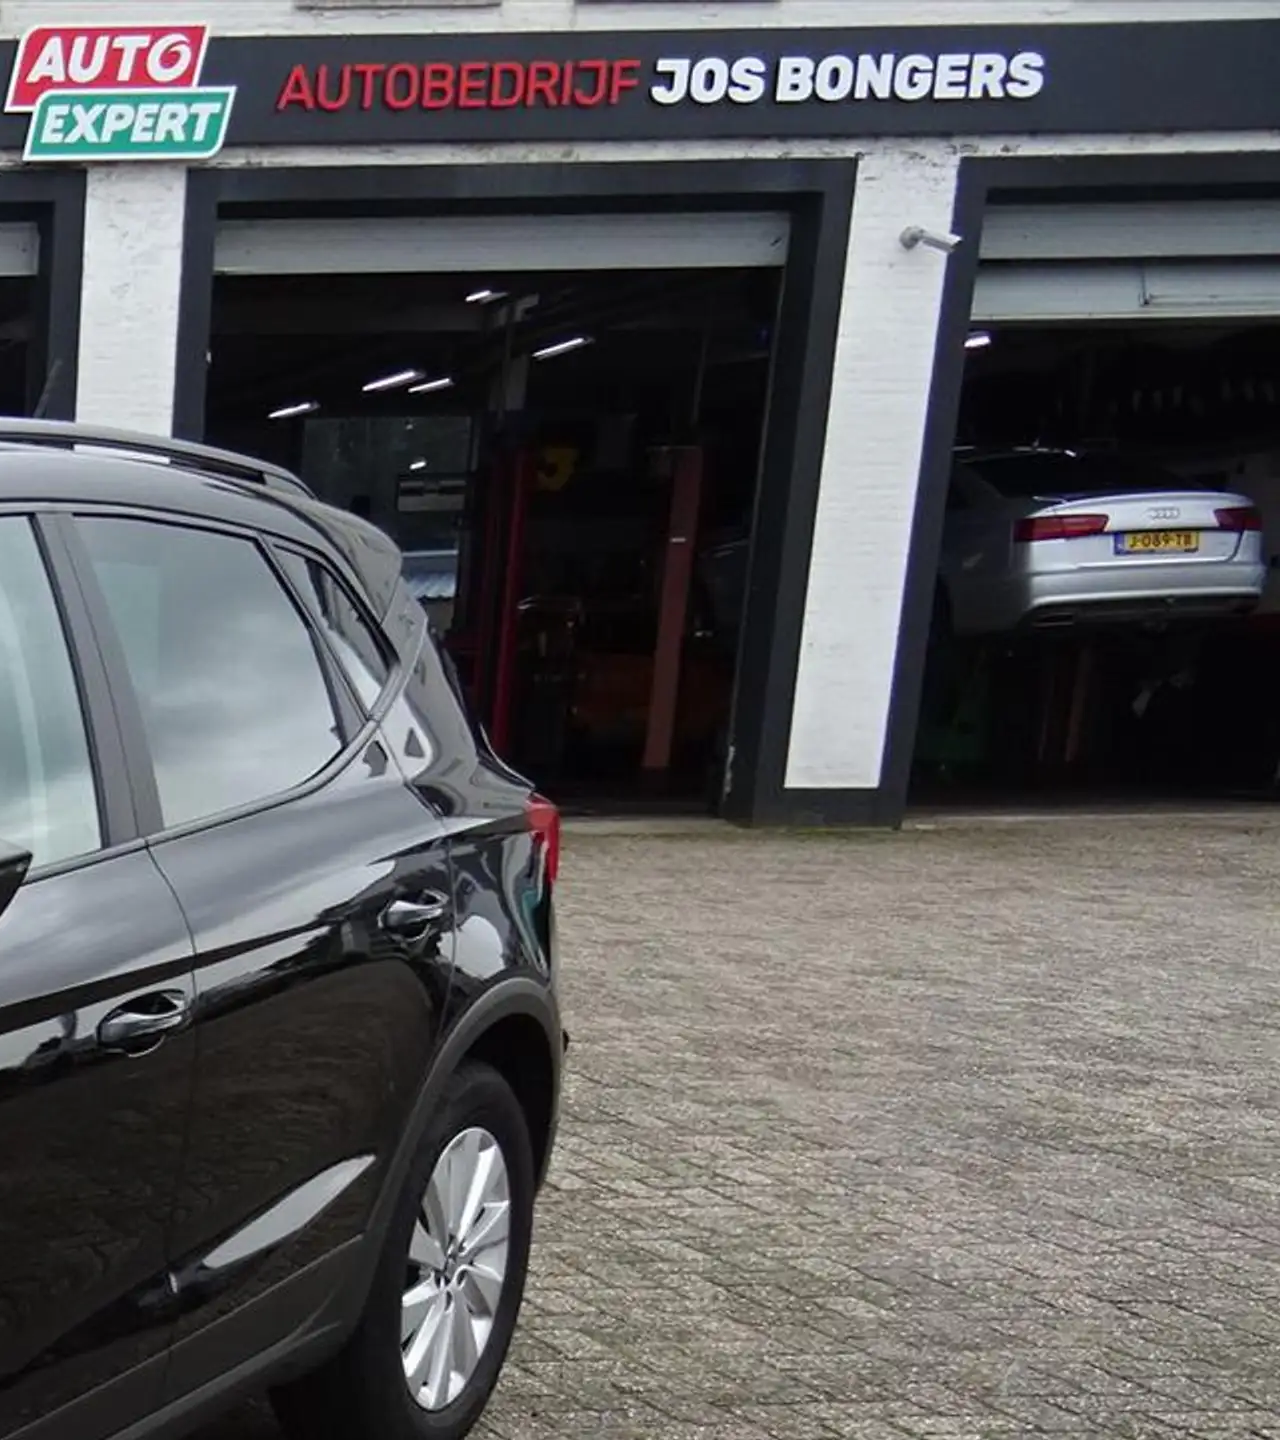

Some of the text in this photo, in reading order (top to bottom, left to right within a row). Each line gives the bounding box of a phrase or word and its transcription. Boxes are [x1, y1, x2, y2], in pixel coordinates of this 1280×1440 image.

[26, 33, 192, 83] AUTO
[276, 52, 1045, 111] AUTOBEDRIJF JOS BONGERS
[40, 102, 222, 144] EXPERT
